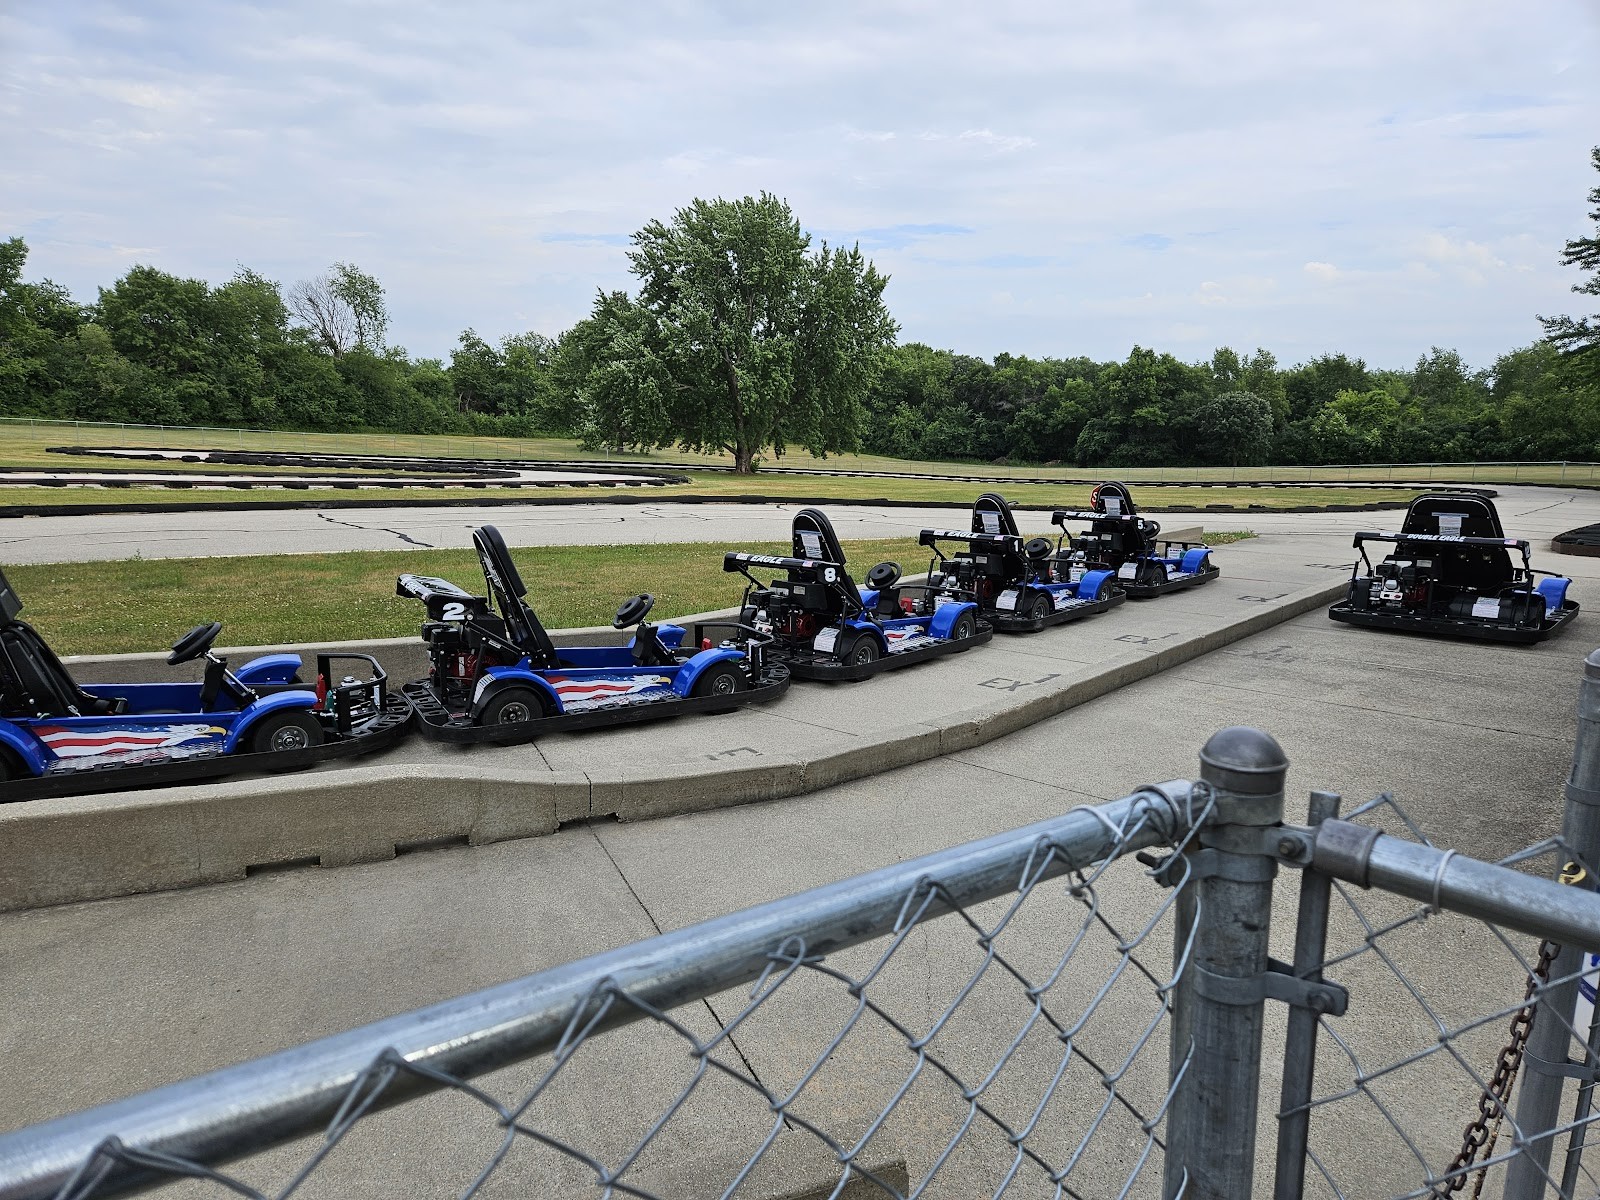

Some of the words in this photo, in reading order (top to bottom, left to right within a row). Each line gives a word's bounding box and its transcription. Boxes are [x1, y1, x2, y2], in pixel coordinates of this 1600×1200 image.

[1078, 511, 1108, 519] EAGLE
[1137, 519, 1144, 530] 5
[947, 530, 979, 539] EAGLE
[1407, 533, 1439, 541] DOUBLE
[1013, 540, 1019, 552] 1
[750, 554, 783, 565] EAGLE
[824, 567, 837, 583] 8
[442, 602, 466, 621] 2
